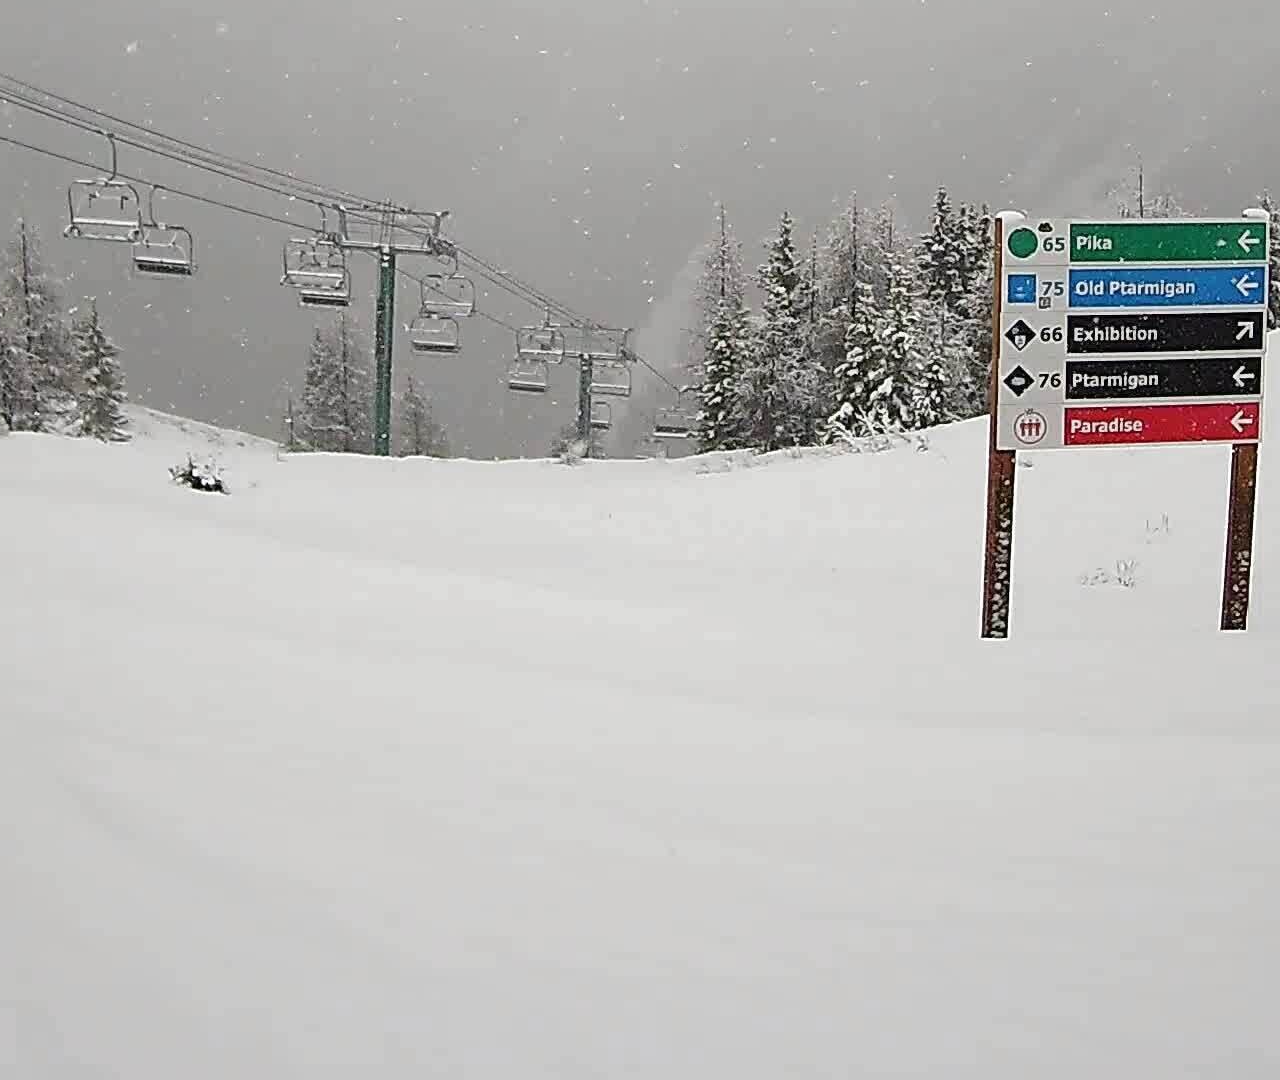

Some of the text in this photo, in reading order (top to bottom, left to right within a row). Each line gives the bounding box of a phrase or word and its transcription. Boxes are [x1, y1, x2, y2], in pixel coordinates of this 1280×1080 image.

[1042, 235, 1113, 252] 65 Pika
[1041, 279, 1195, 298] 75 Old Ptarmigan
[1040, 326, 1158, 342] 66 Exhibition
[1038, 373, 1062, 388] 76
[1072, 372, 1159, 391] Ptarmigan
[1070, 418, 1143, 434] Paradise
